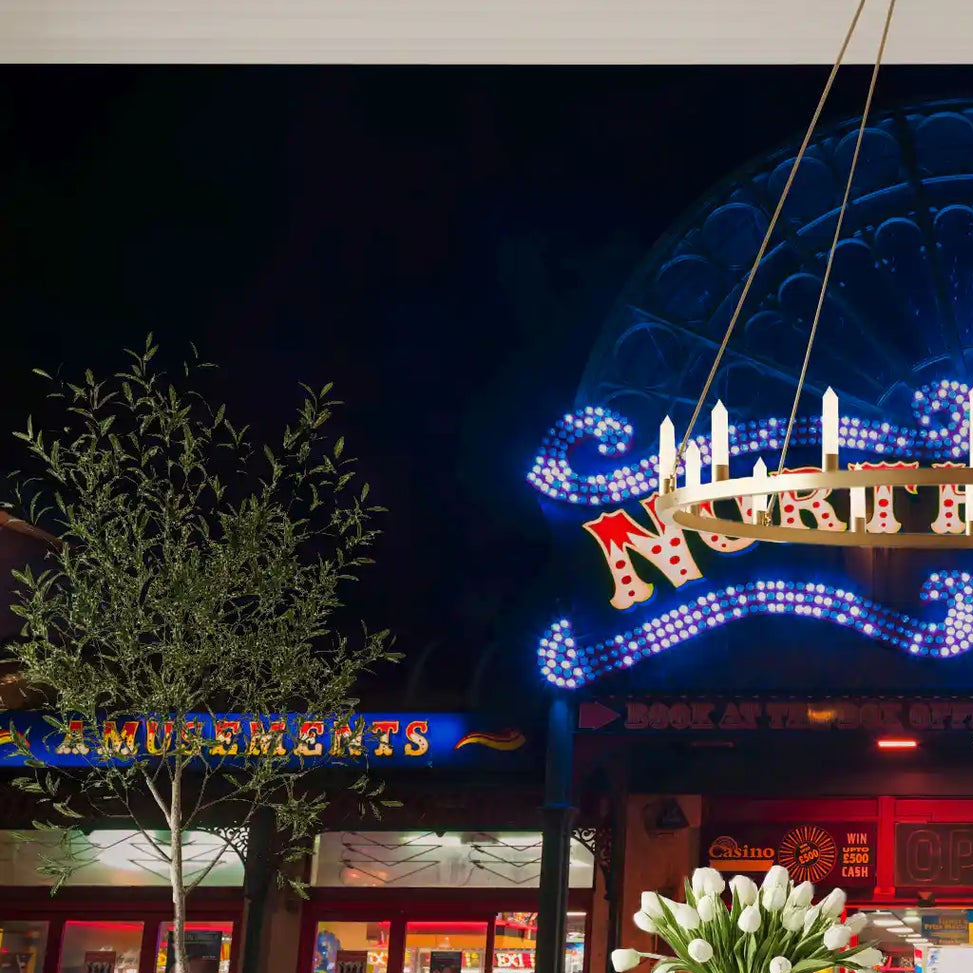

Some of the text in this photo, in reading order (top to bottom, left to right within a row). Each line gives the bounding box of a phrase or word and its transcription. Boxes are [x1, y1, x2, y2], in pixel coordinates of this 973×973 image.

[624, 702, 715, 730] BOOK
[719, 702, 762, 730] AT
[766, 702, 833, 730] TH
[55, 720, 429, 756] AMUSEMENTS
[847, 833, 868, 844] WIN
[709, 844, 775, 858] Casino
[799, 849, 820, 865] £500
[843, 853, 869, 864] £500
[842, 867, 869, 877] CASH
